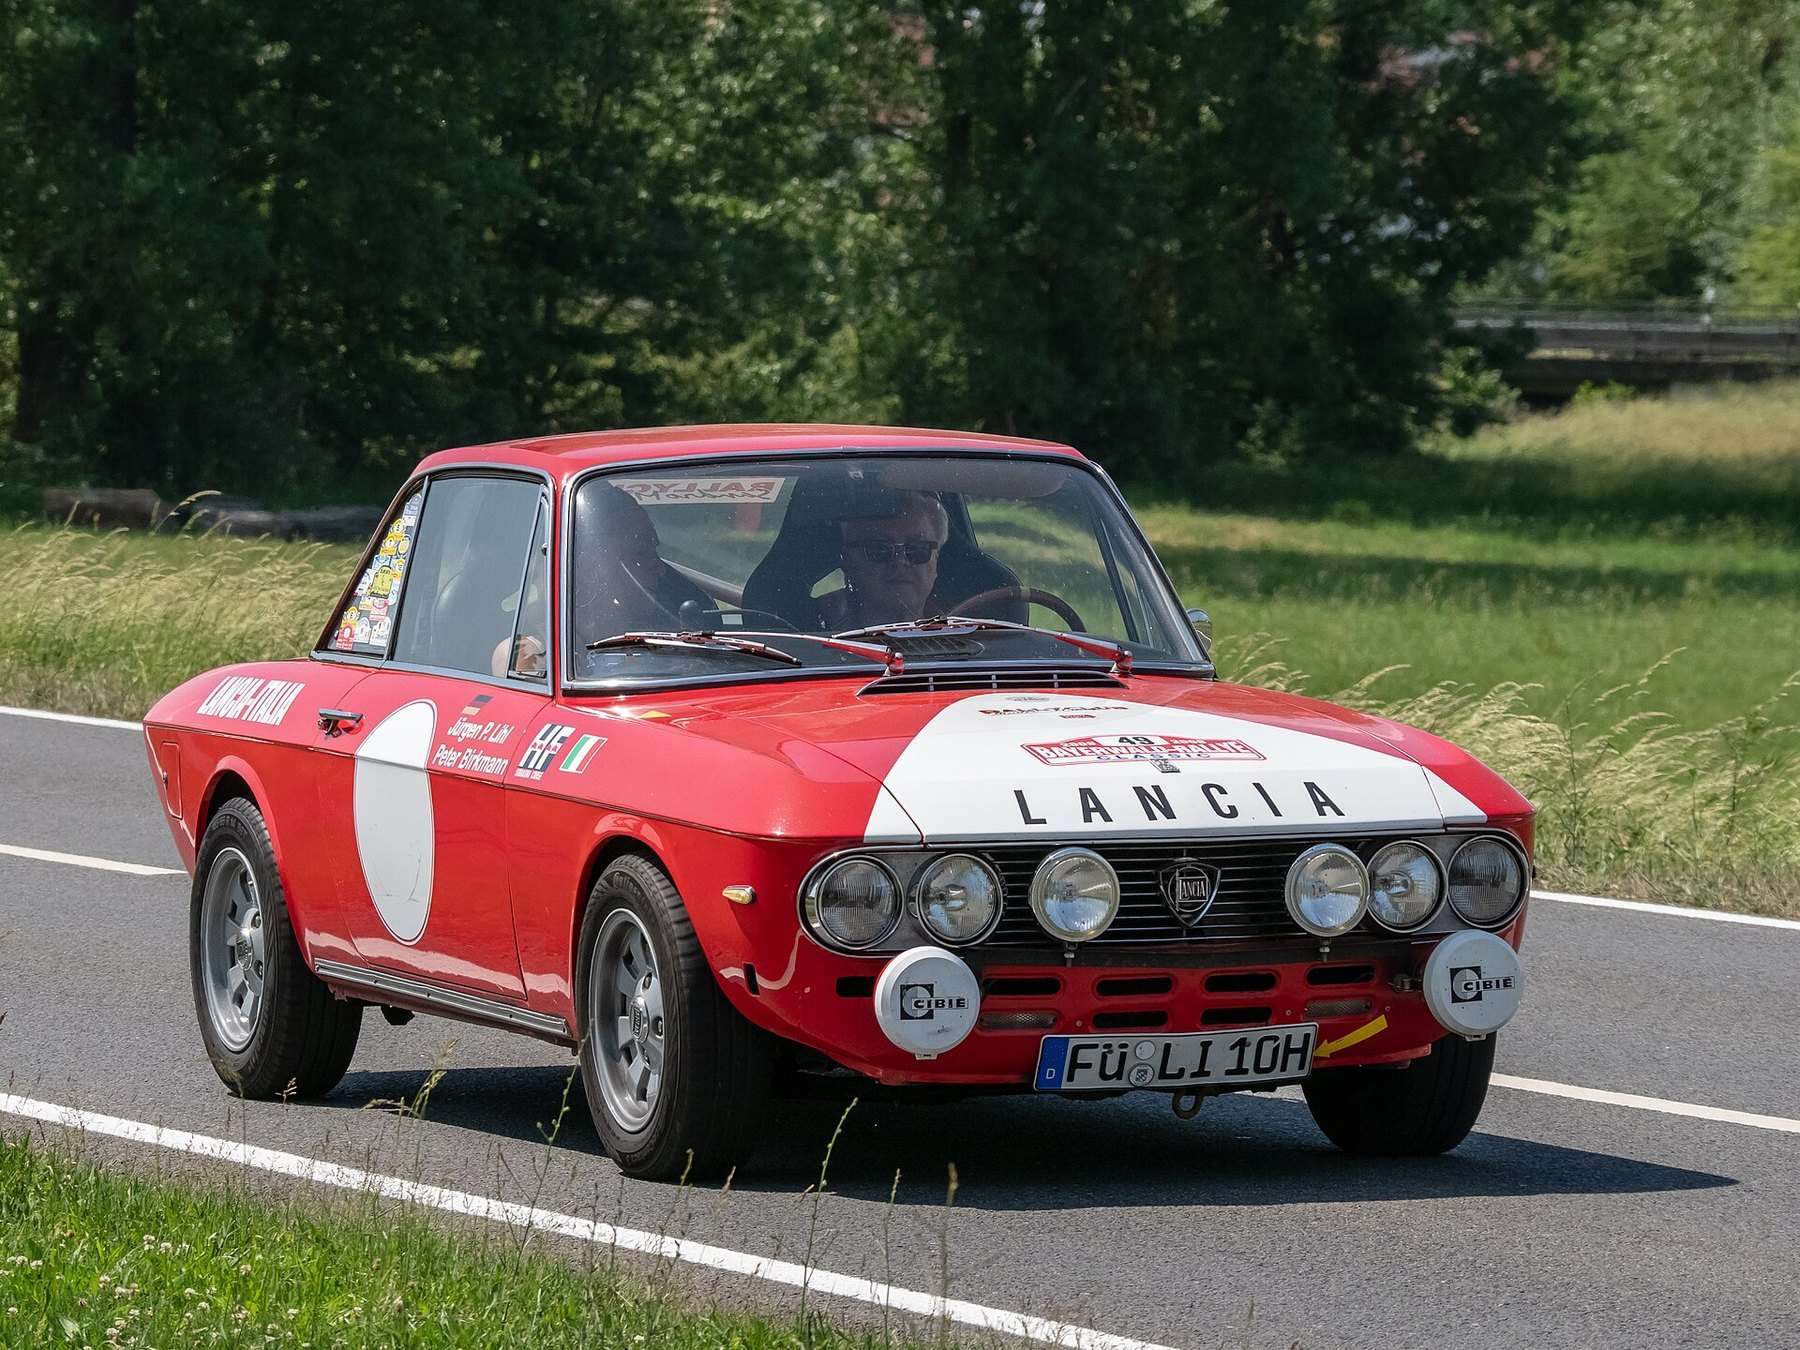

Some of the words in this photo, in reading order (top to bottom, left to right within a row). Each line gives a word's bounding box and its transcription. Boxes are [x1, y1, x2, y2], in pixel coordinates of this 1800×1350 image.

[447, 716, 483, 742] Jürgen
[477, 721, 495, 742] P.
[1117, 736, 1154, 745] 49
[432, 743, 460, 768] Peter
[458, 746, 509, 776] Birkmann
[518, 723, 576, 770] HF
[1013, 781, 1346, 825] LANCIA
[1178, 879, 1206, 900] LANCIA
[1066, 1042, 1129, 1083] FÜ
[1157, 1040, 1213, 1080] LI
[1224, 1032, 1311, 1077] 10H
[1045, 1068, 1056, 1080] D
